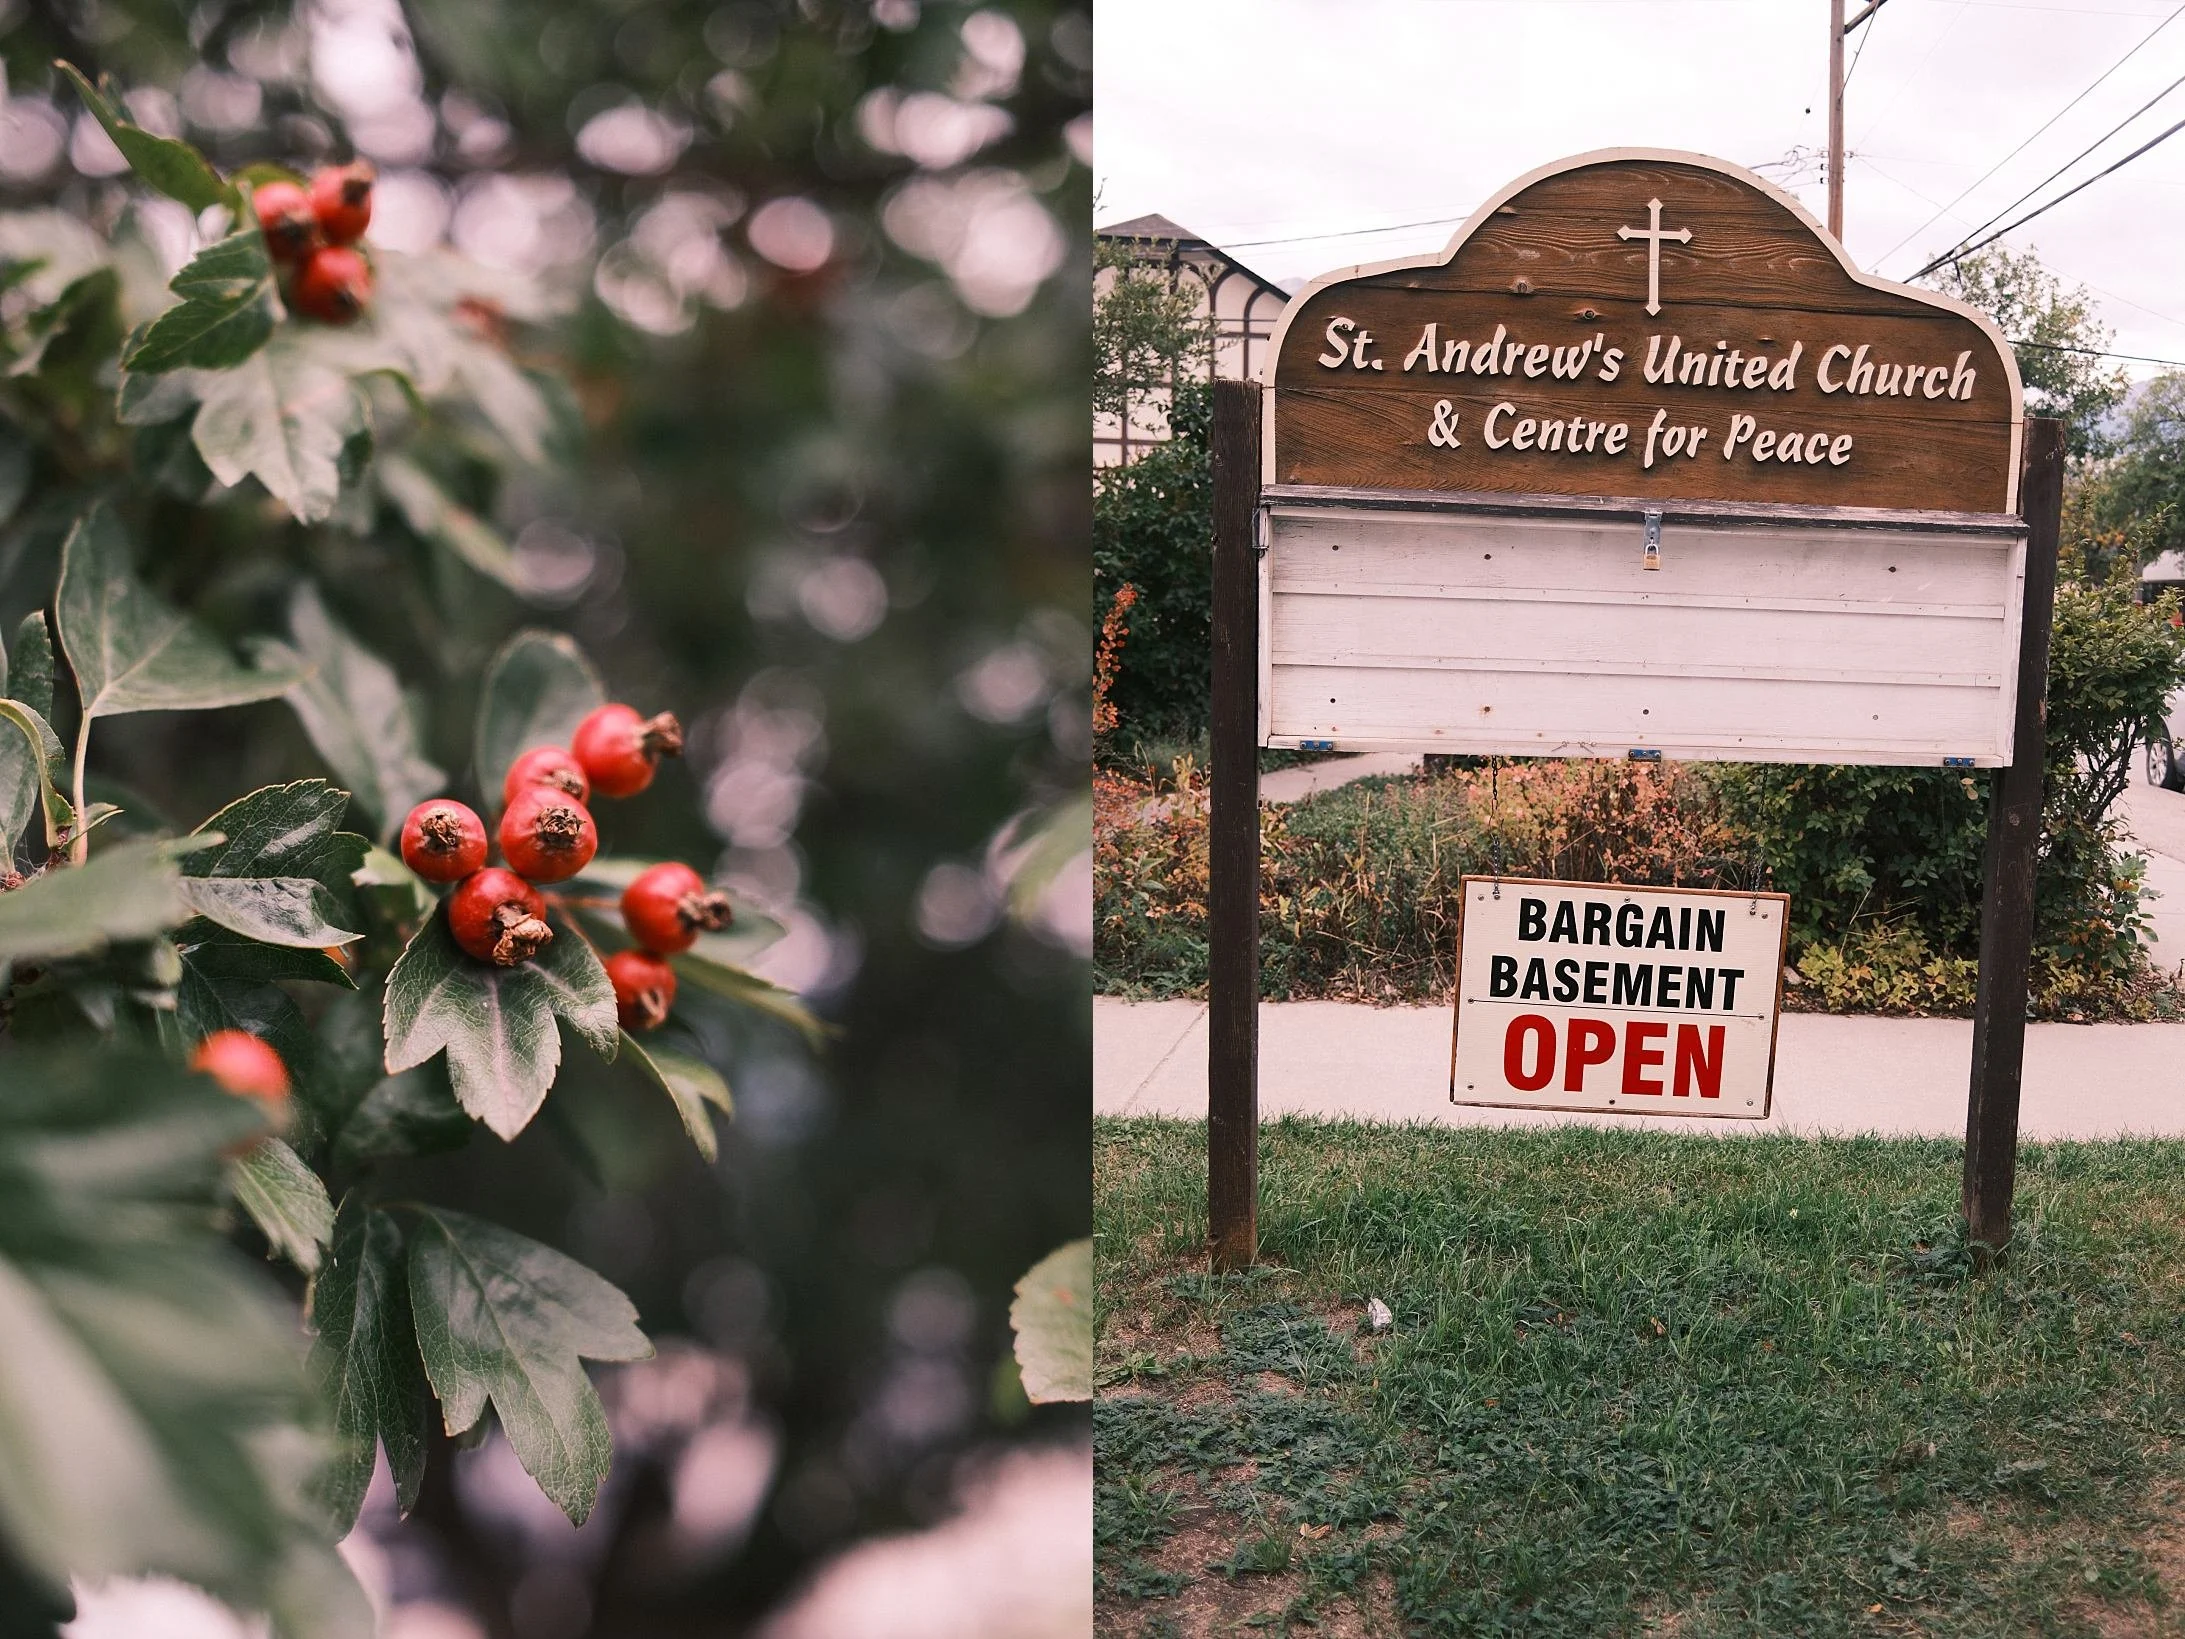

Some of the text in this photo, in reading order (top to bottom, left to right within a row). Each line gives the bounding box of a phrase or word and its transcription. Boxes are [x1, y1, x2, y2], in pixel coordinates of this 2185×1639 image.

[1318, 317, 1977, 401] St. Andrew's United Church
[1427, 399, 1854, 468] & Centre for Peace
[1518, 897, 1725, 952] BARGAIN
[1489, 955, 1744, 1010] BASEMENT
[1503, 1014, 1726, 1098] OPEN
